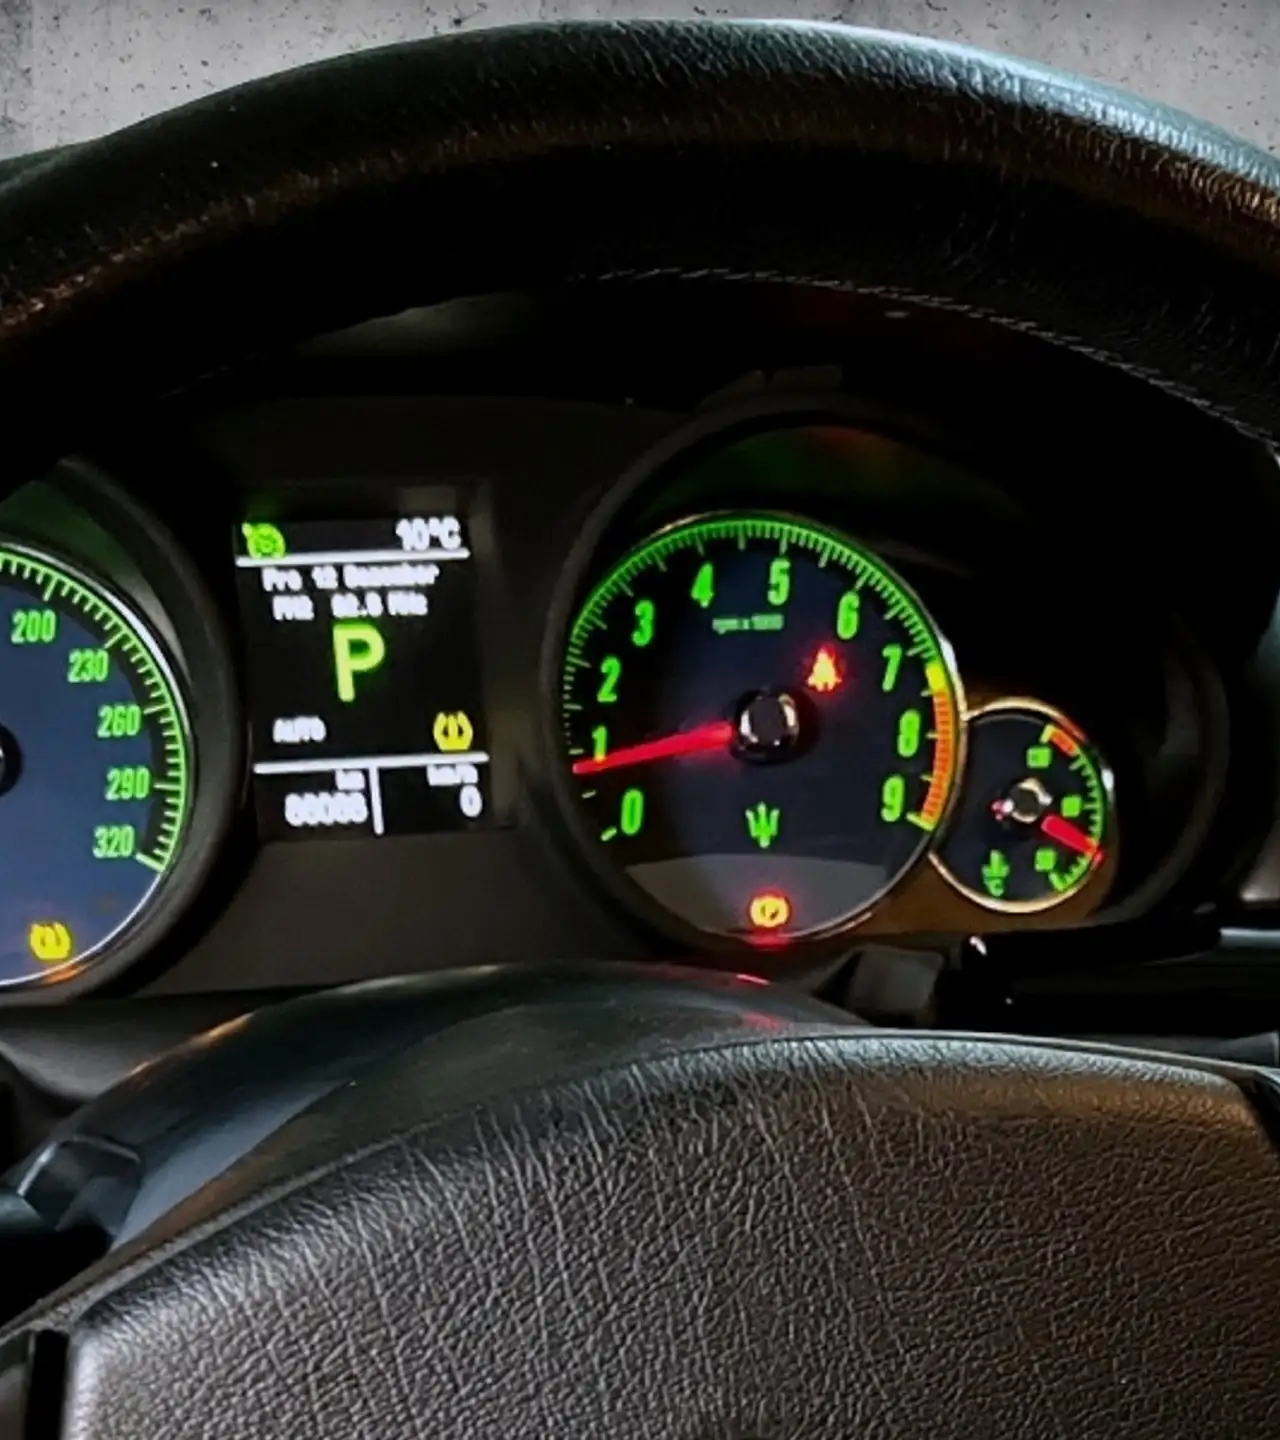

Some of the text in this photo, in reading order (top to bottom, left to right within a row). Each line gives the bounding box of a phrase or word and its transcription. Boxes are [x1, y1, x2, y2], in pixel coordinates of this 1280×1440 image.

[691, 563, 714, 607] 4
[768, 558, 791, 606] 5
[11, 609, 56, 644] 200
[632, 600, 655, 646] 3
[837, 591, 860, 639] 6
[67, 649, 110, 684] 230
[333, 623, 385, 702] P
[597, 656, 620, 702] 2
[882, 644, 902, 692] 7
[96, 704, 141, 738] 260
[592, 726, 607, 761] 1
[898, 710, 921, 758] 8
[104, 766, 151, 801] 290
[882, 775, 905, 822] 9
[620, 789, 644, 835] 0
[93, 824, 136, 859] 320
